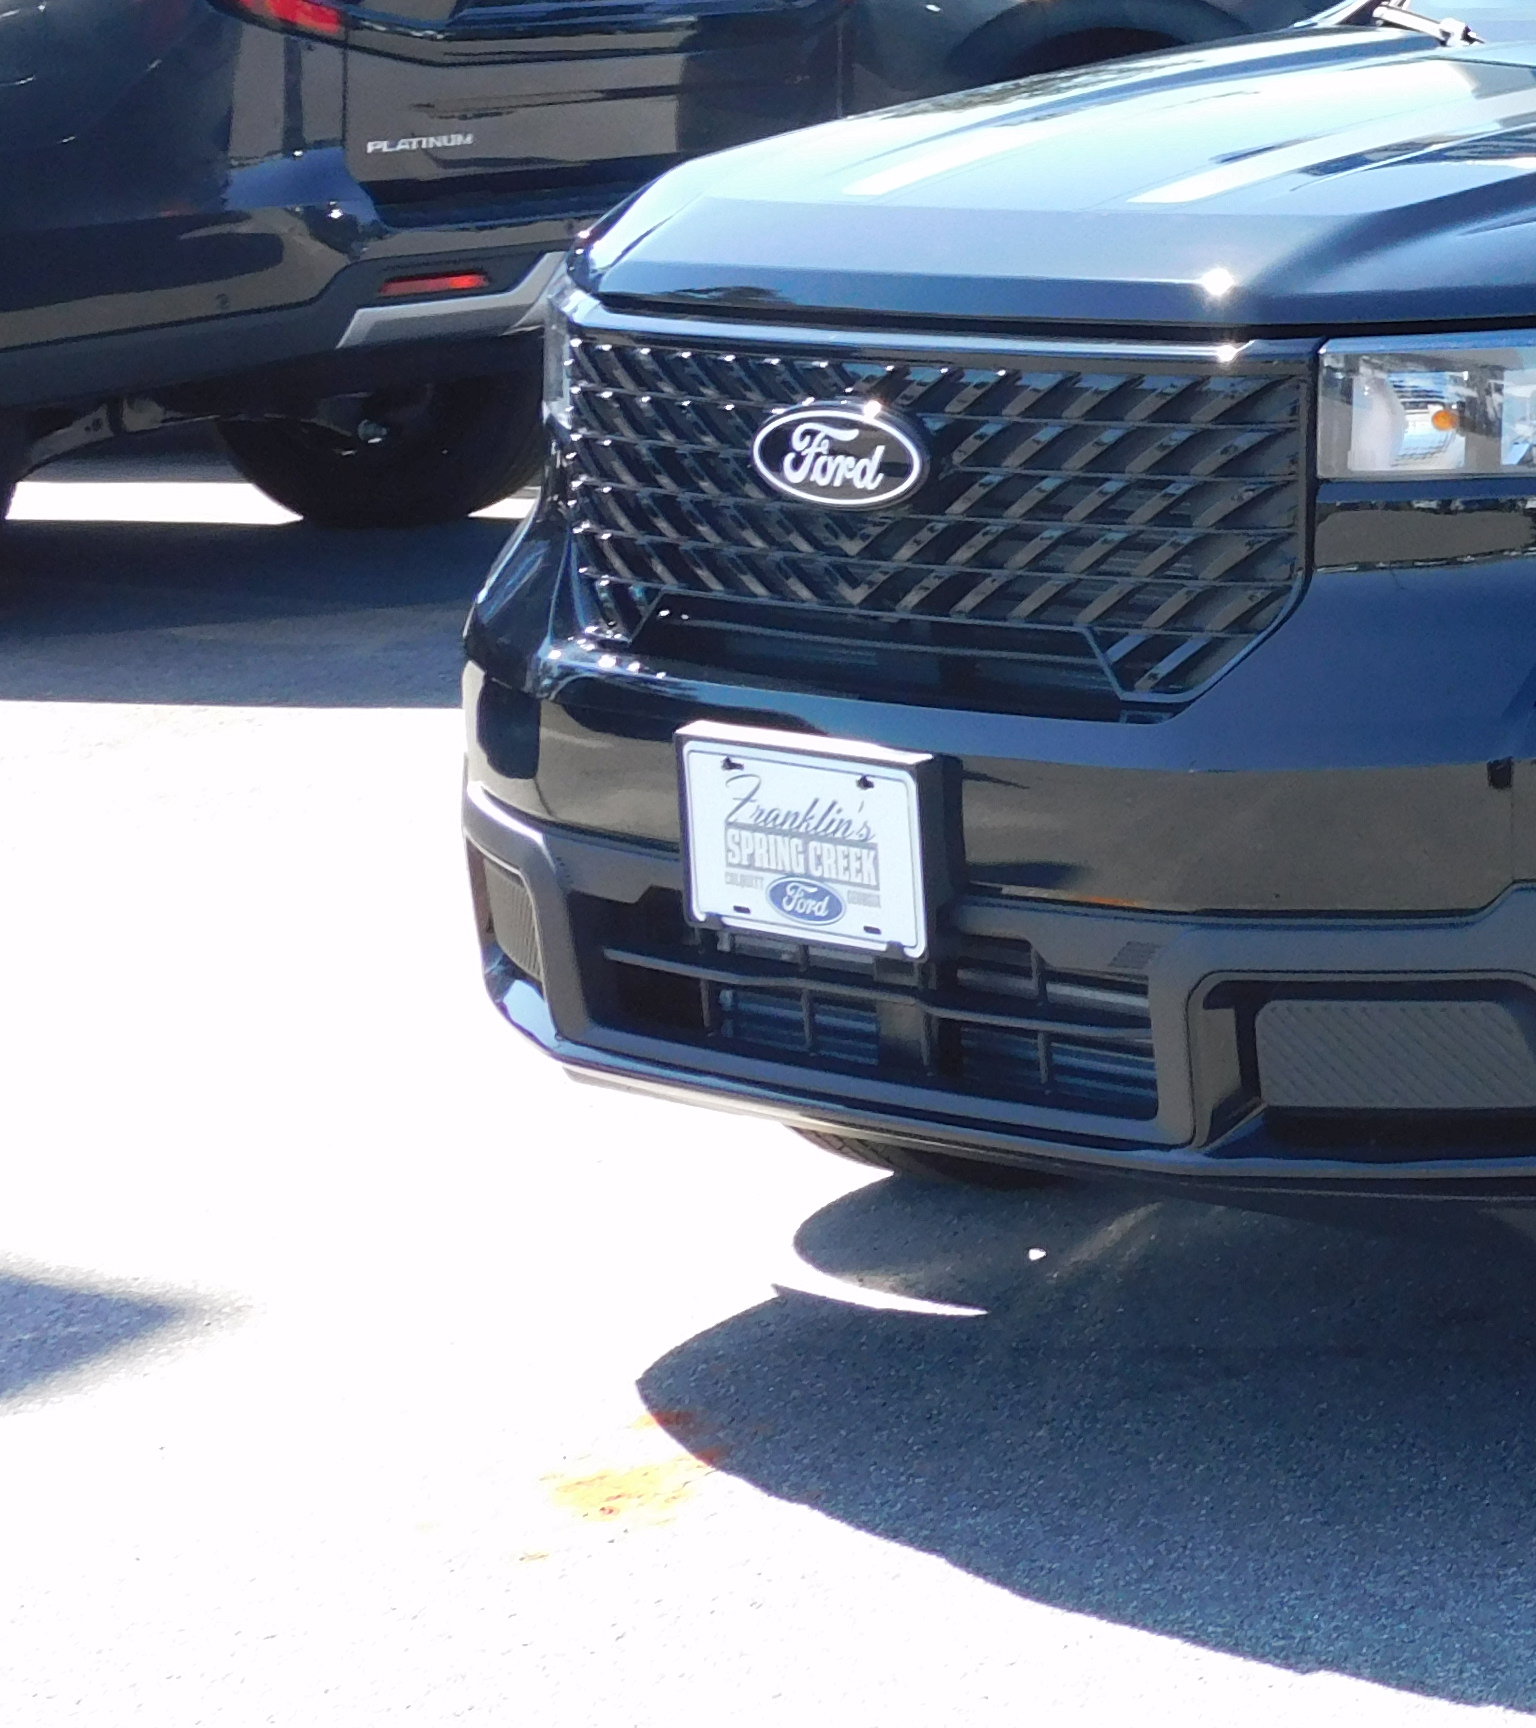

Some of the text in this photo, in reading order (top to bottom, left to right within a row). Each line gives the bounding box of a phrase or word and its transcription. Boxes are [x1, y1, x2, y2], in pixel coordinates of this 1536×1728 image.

[366, 133, 473, 154] PLATINUM
[783, 422, 886, 491] Ford
[724, 774, 876, 841] Franklin's
[727, 830, 877, 887] SPRING CREEK
[782, 881, 830, 917] Ford
